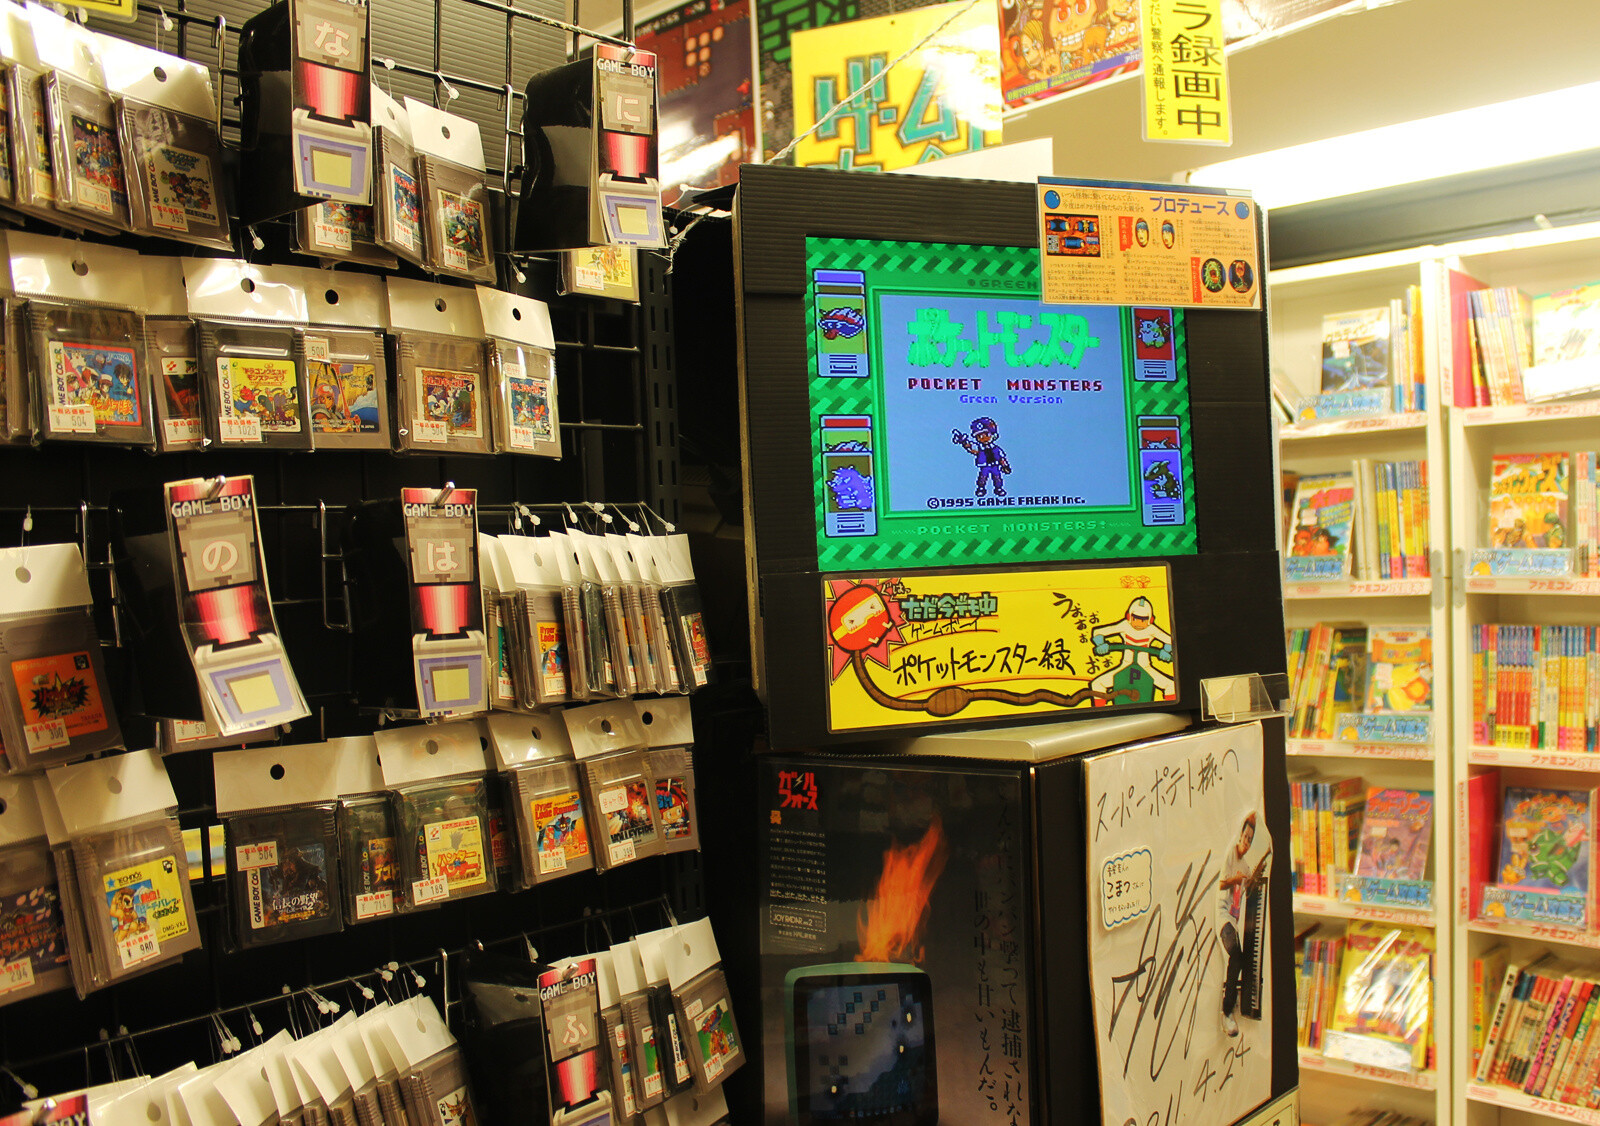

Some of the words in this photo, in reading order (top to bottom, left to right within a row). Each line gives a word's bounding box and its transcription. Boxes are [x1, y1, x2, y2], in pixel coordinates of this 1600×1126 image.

[313, 20, 351, 57] な
[596, 57, 628, 75] GAME
[631, 63, 655, 79] BOY
[616, 94, 642, 123] に
[1149, 196, 1230, 217] プロデュース
[906, 307, 1100, 369] ポケットモンスター
[907, 377, 982, 391] POCKET
[1006, 378, 1103, 392] MONSTERS
[959, 394, 998, 406] Green
[1008, 395, 1063, 404] Version
[71, 415, 87, 427] 504
[170, 500, 213, 519] GAME
[220, 493, 251, 513] BOY
[403, 502, 438, 518] GAME
[445, 502, 474, 518] BOY
[926, 497, 974, 510] ©1995
[976, 497, 1016, 507] GAME
[1017, 496, 1060, 506] FREAK
[1062, 495, 1087, 505] Inc.
[916, 524, 990, 535] POCKET
[201, 539, 240, 573] の
[427, 540, 460, 573] は
[911, 616, 981, 641] ゲームボーイ
[893, 638, 1076, 686] ポケットモンスター緑
[252, 886, 261, 902] BOY
[430, 883, 444, 899] 189
[252, 901, 263, 923] GAME
[540, 981, 569, 1001] GAME
[573, 971, 596, 991] BOY
[562, 1013, 590, 1045] ふ
